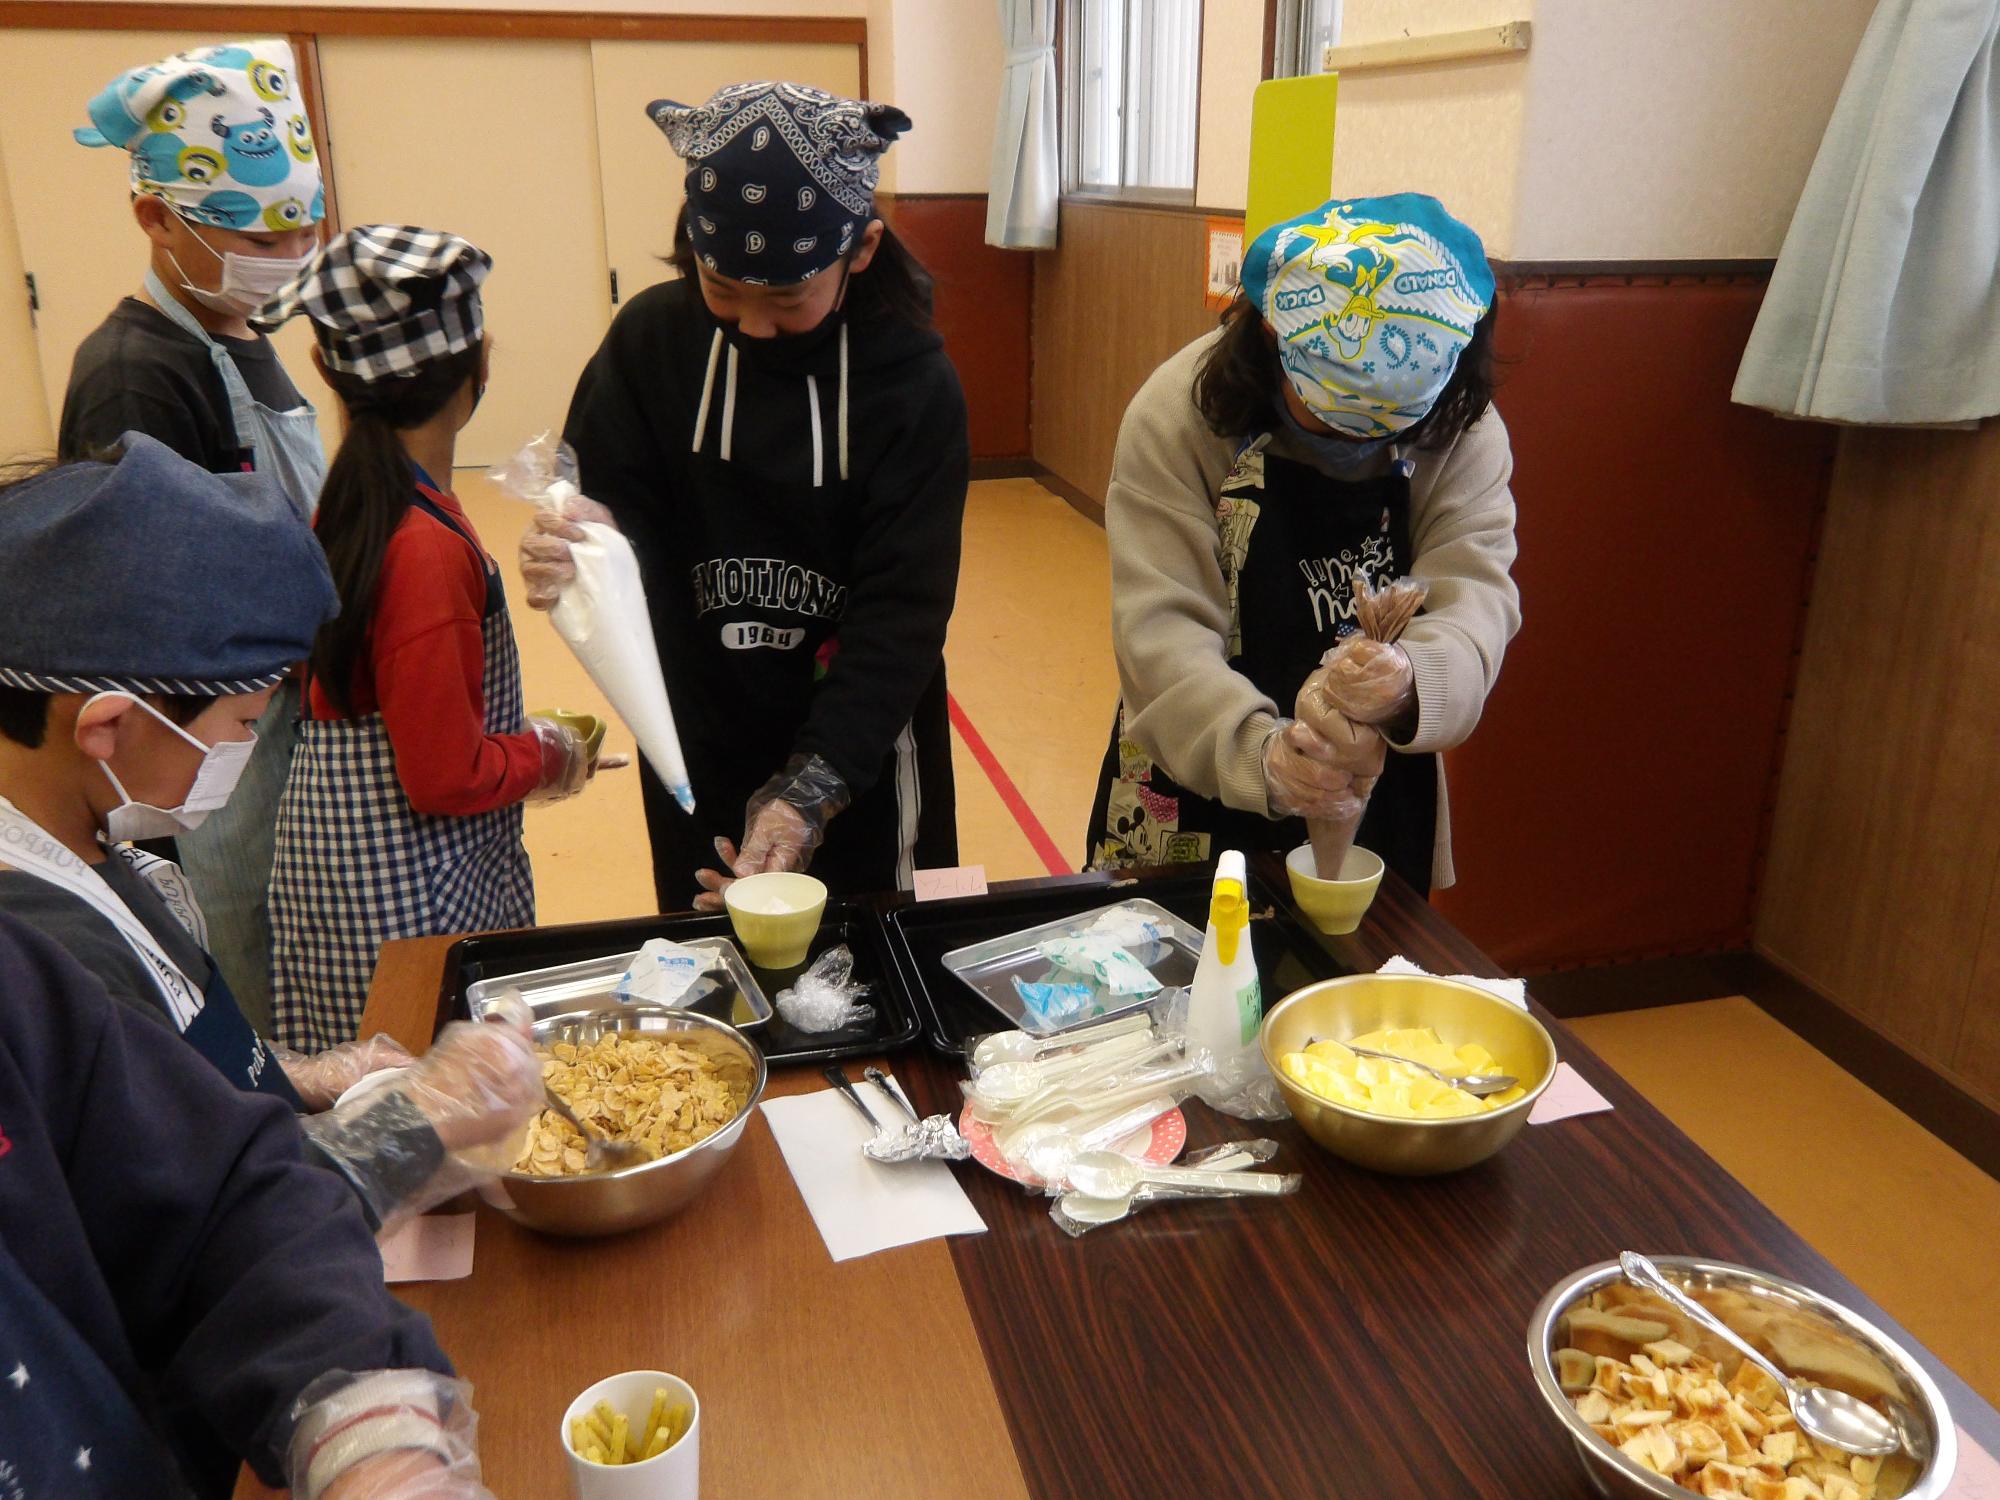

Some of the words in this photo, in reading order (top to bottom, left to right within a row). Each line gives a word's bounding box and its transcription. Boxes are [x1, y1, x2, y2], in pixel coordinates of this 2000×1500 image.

[1394, 268, 1458, 295] DONALD
[1276, 286, 1325, 311] DUCK
[737, 625, 792, 647] 1964
